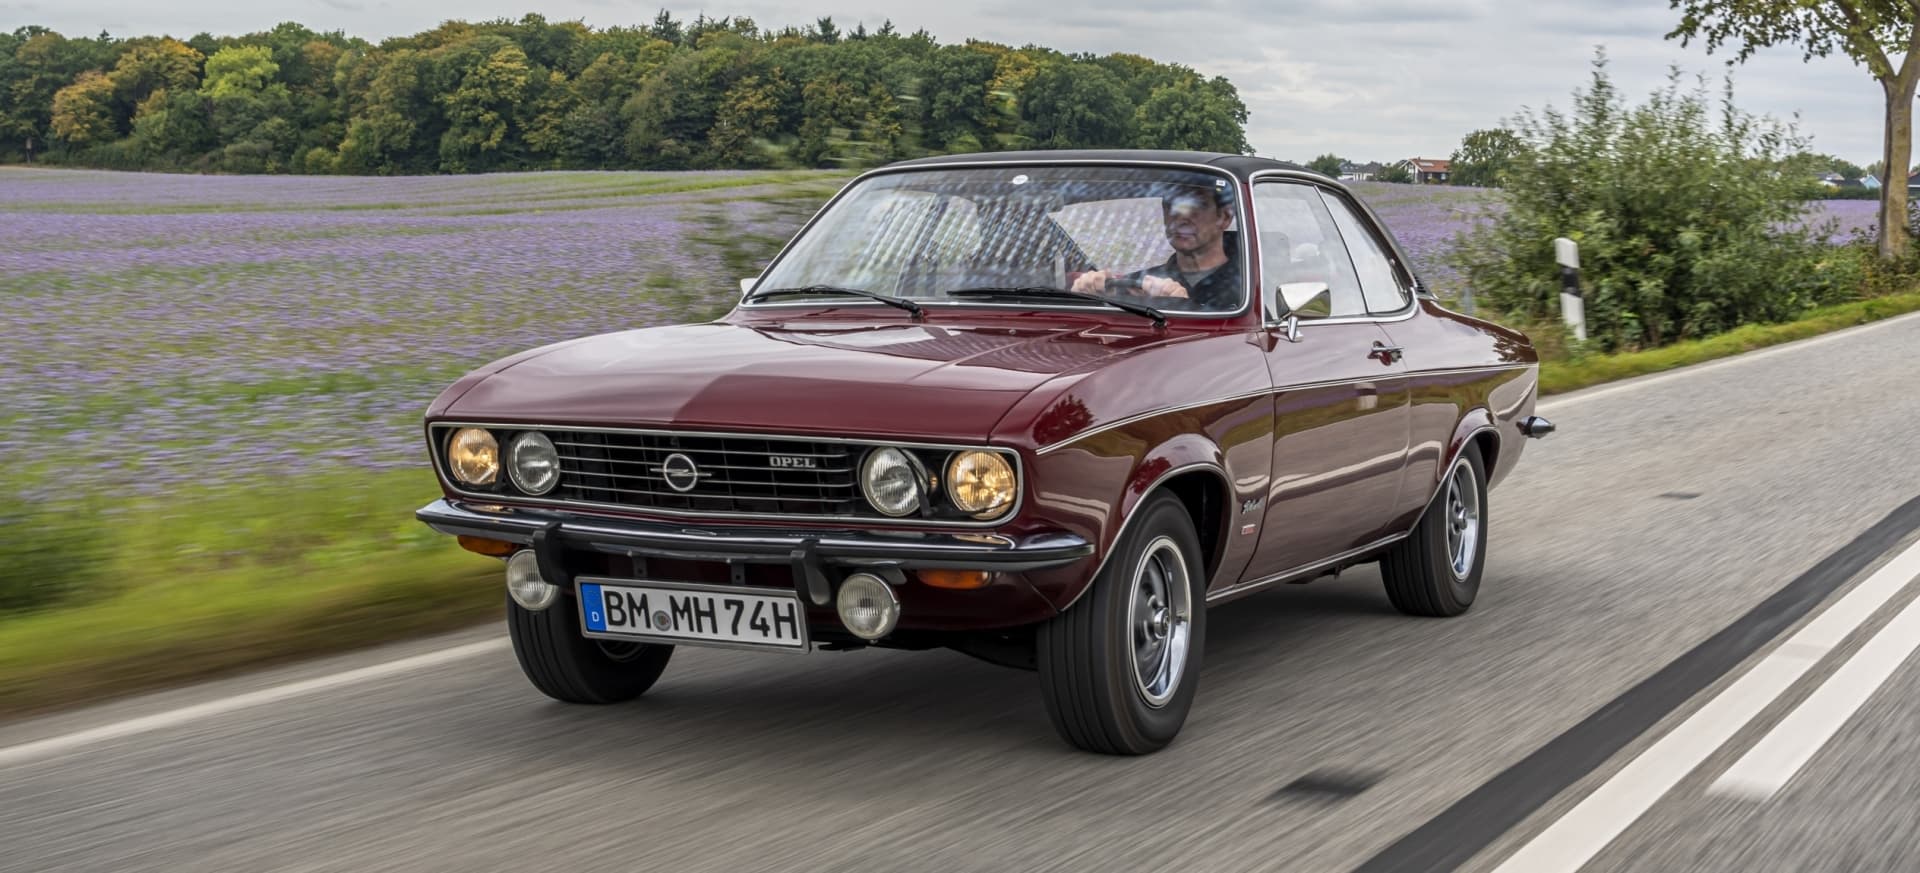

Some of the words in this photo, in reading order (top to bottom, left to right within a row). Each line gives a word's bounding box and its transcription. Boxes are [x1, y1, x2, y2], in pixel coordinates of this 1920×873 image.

[770, 456, 816, 469] OPEL
[591, 611, 600, 622] D
[604, 590, 651, 629] BM
[669, 595, 718, 634] MH
[724, 599, 799, 640] 74H
